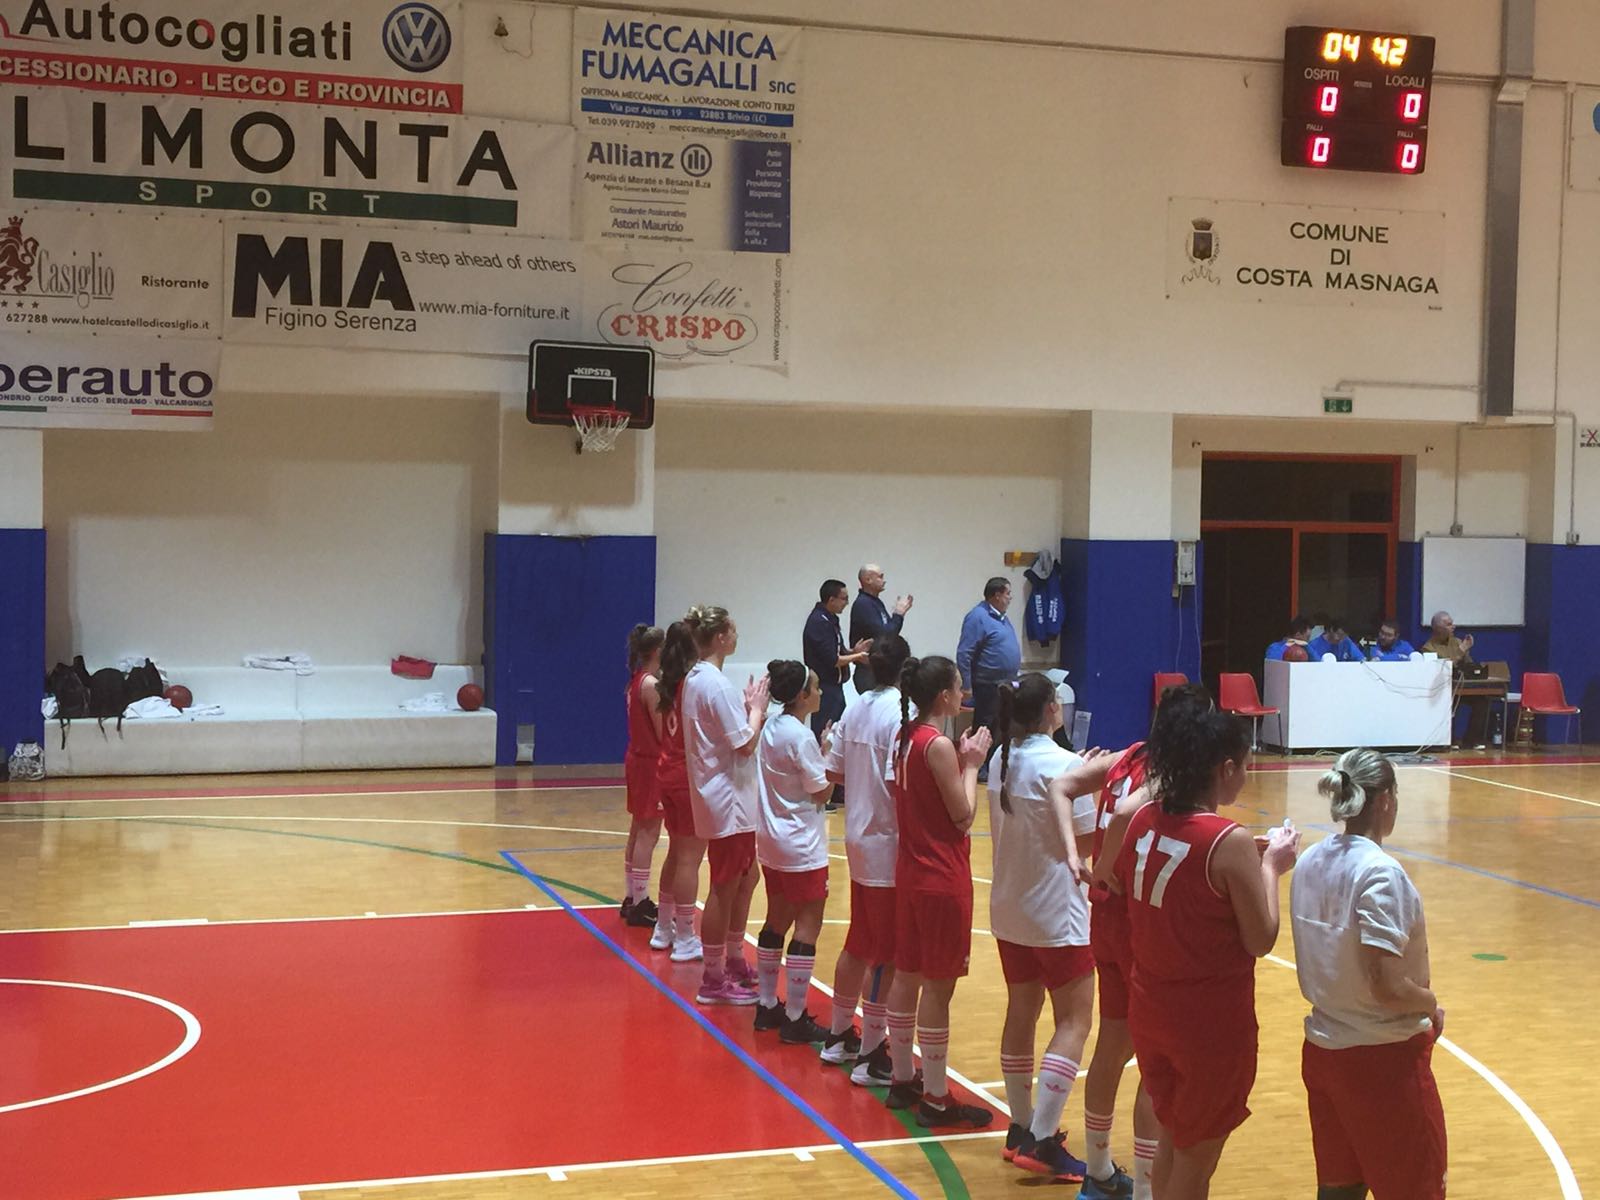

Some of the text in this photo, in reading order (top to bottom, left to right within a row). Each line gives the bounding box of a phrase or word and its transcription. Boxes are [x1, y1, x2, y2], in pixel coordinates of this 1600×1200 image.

[19, 0, 352, 62] Autocogliati
[602, 19, 777, 61] MECCANICA
[1323, 32, 1408, 66] 04 42
[0, 56, 178, 89] CESSIONARIO
[202, 72, 286, 96] LECCO
[294, 80, 310, 98] E
[317, 80, 450, 109] PROVINCIA
[581, 49, 796, 95] FUMAGALLI snc
[1304, 67, 1340, 82] OSPITI
[1385, 75, 1425, 88] LOCALI
[581, 87, 620, 99] OFFICINA
[621, 89, 670, 103] MECCANICA
[682, 95, 740, 109] LAVORAZIONE
[742, 100, 771, 111] CONTO
[773, 102, 795, 112] TERZI
[609, 102, 625, 112] Via
[671, 107, 682, 117] 19
[1321, 86, 1339, 112] 0
[1403, 93, 1422, 119] 0
[14, 95, 518, 190] LIMONTA
[587, 141, 675, 170] Allianz
[1312, 137, 1330, 162] 0
[1401, 143, 1419, 169] 0
[584, 171, 618, 184] Agenzia
[618, 173, 627, 184] di
[665, 177, 694, 188] Besana
[138, 181, 380, 214] SPORT
[609, 205, 647, 216] Consulente
[611, 217, 684, 233] Astori Maurizio
[1290, 222, 1389, 244] COMUNE
[401, 249, 577, 273] a step ahead of others
[1330, 248, 1351, 266] DI
[37, 248, 115, 309] Casiglio
[141, 275, 210, 290] Ristorante
[232, 233, 416, 319] MIA
[612, 261, 743, 315] Confetti
[1236, 267, 1439, 294] COSTA MASNAGA
[6, 313, 210, 331] 627288 www.hotelcastellodicasiglio.it
[264, 307, 417, 333] Figino Serenza
[418, 300, 571, 321] www.mia-forniture.it
[773, 258, 782, 360] www.crispoconfetti.com
[611, 314, 746, 342] CRISPO
[38, 395, 64, 403] COMO
[71, 396, 99, 404] LECCO
[106, 397, 148, 405] BERGAMO
[154, 398, 214, 407] VALCAMONICA
[1135, 829, 1191, 908] 17
